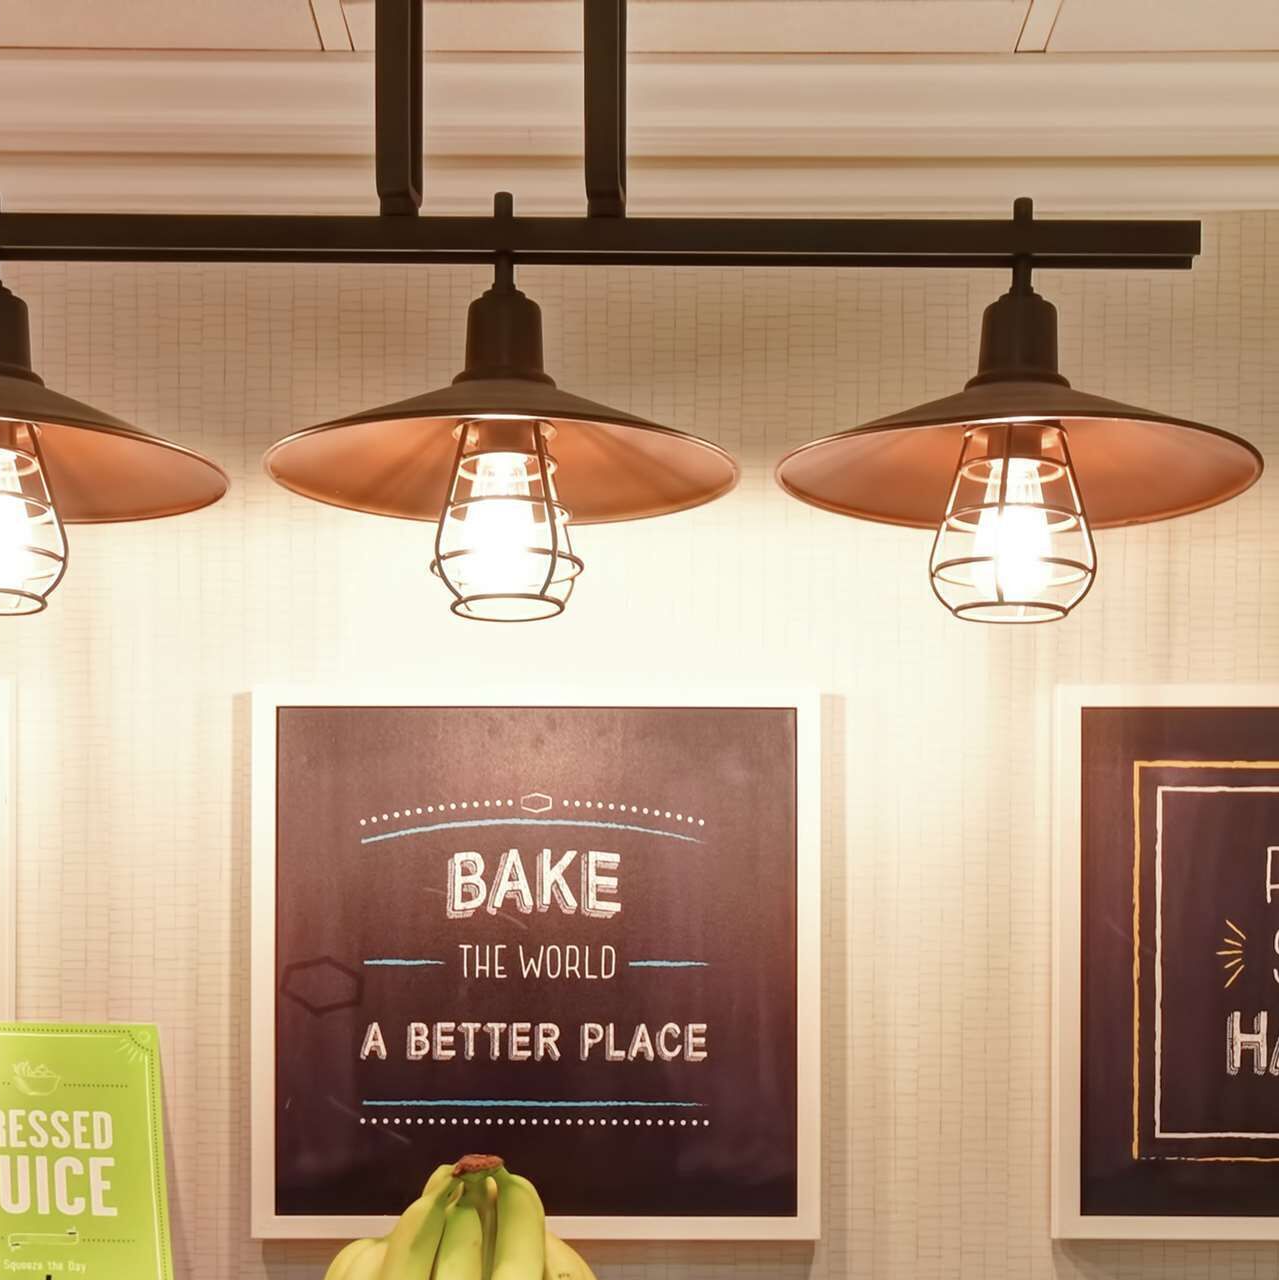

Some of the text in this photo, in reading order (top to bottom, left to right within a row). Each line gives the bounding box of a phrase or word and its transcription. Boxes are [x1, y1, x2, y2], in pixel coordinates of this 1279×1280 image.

[446, 848, 621, 919] BAKE
[459, 944, 617, 979] THE WORLD
[360, 1022, 709, 1062] A BETTER PLACE
